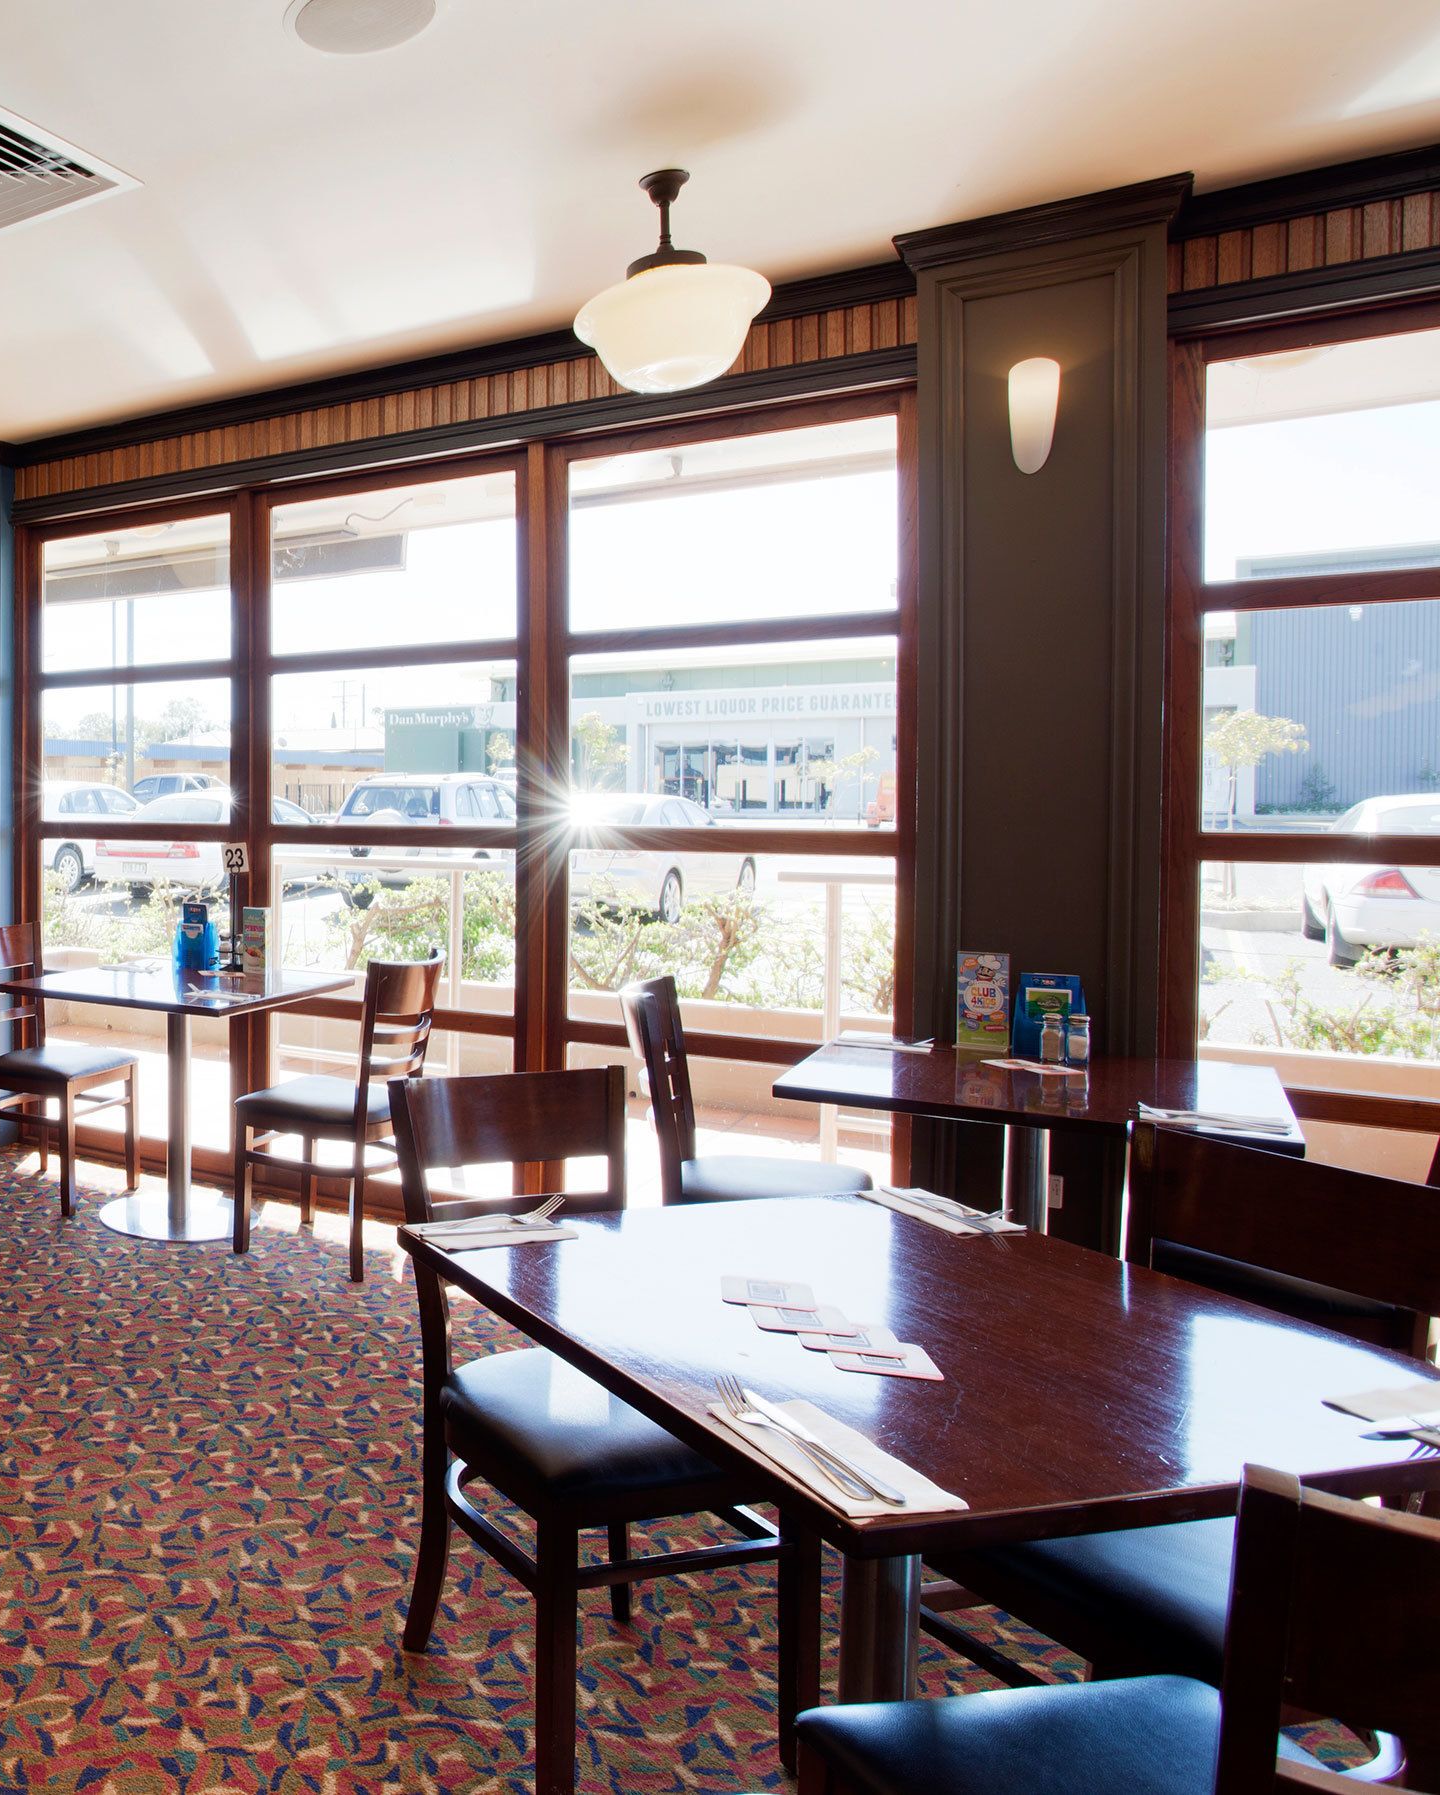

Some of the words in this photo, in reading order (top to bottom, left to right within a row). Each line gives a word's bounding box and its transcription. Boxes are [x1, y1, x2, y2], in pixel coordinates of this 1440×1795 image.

[646, 699, 701, 717] LOWEST
[706, 697, 756, 715] LIQUOR
[761, 695, 804, 713] PRICE
[225, 848, 244, 868] 23
[971, 986, 997, 998] CLUB
